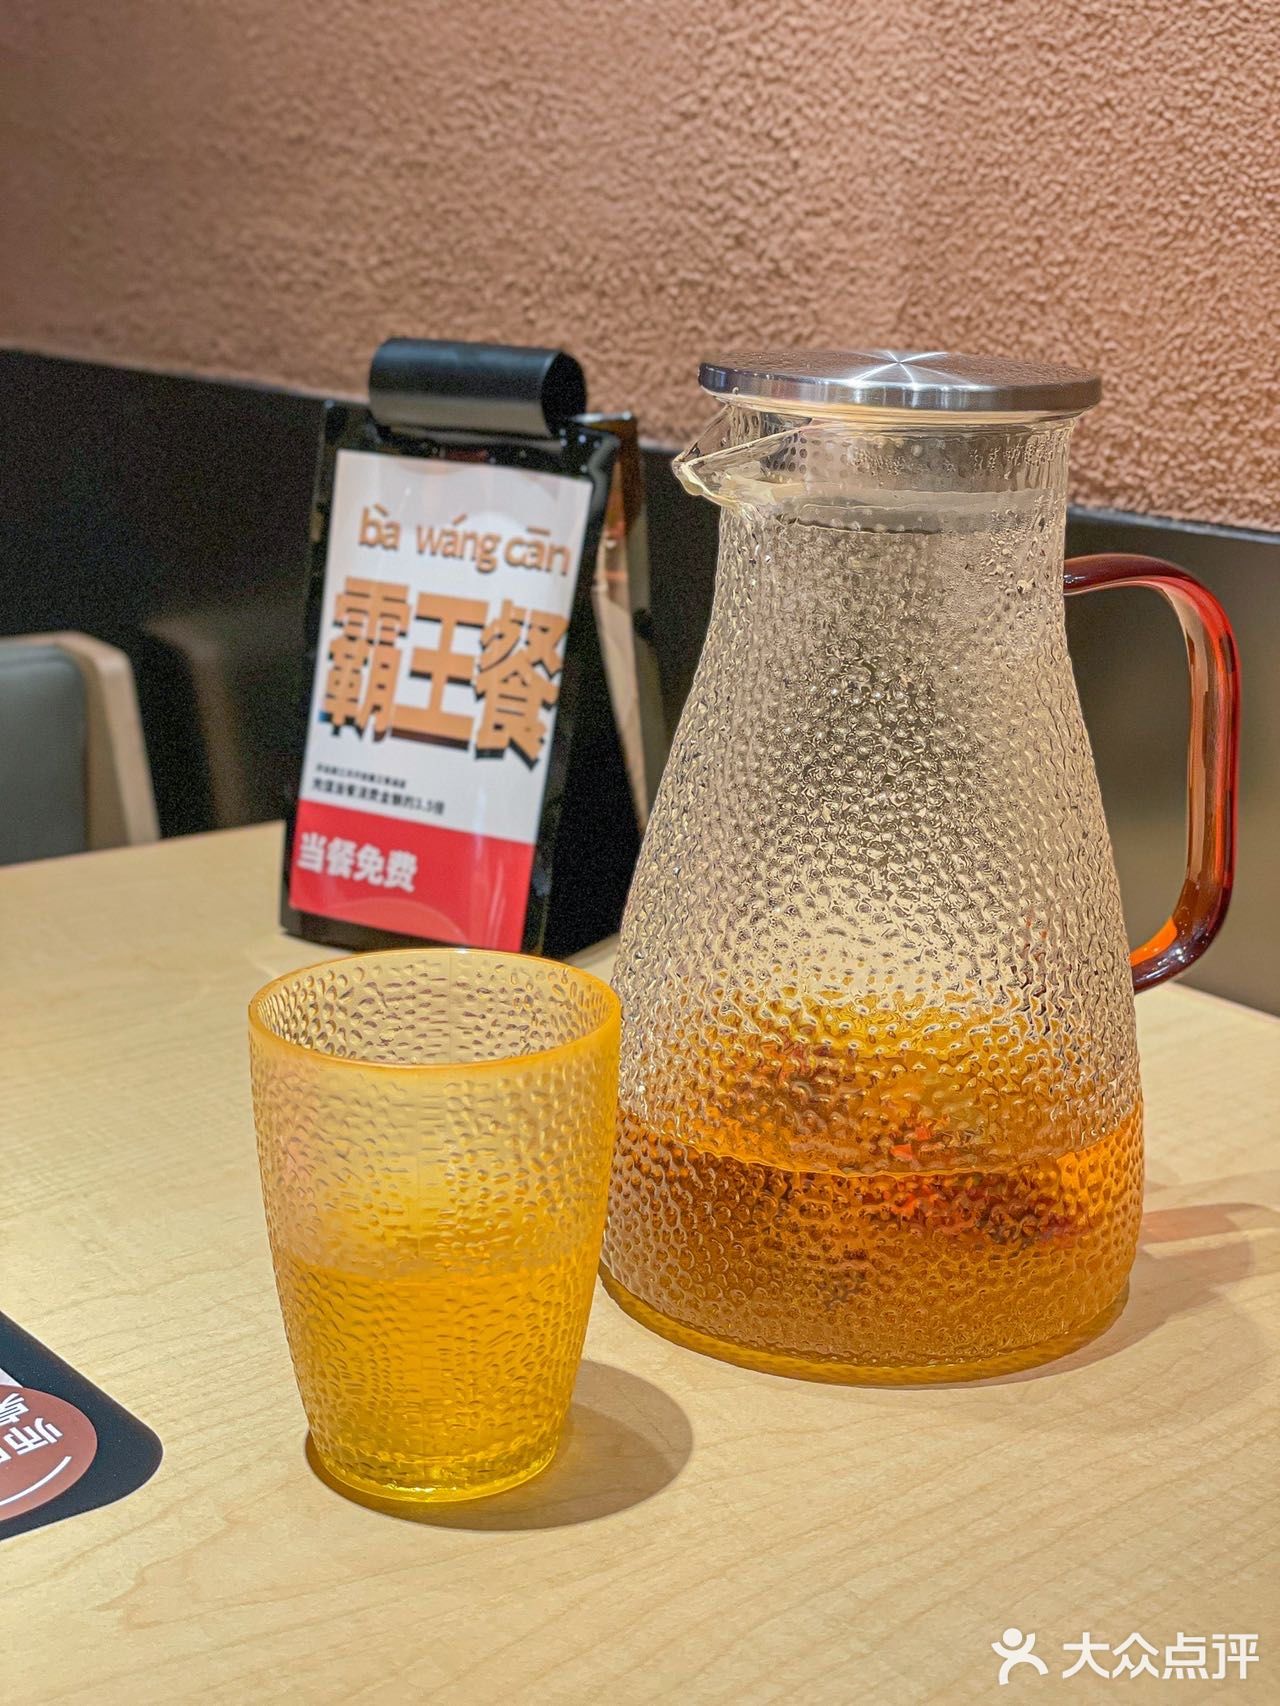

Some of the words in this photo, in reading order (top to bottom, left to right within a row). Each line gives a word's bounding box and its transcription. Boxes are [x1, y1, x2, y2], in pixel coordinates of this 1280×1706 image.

[359, 504, 398, 548] bà
[415, 514, 501, 574] wáng
[502, 527, 572, 577] cān
[320, 576, 570, 769] 霸王餐
[297, 832, 418, 893] 当餐免费
